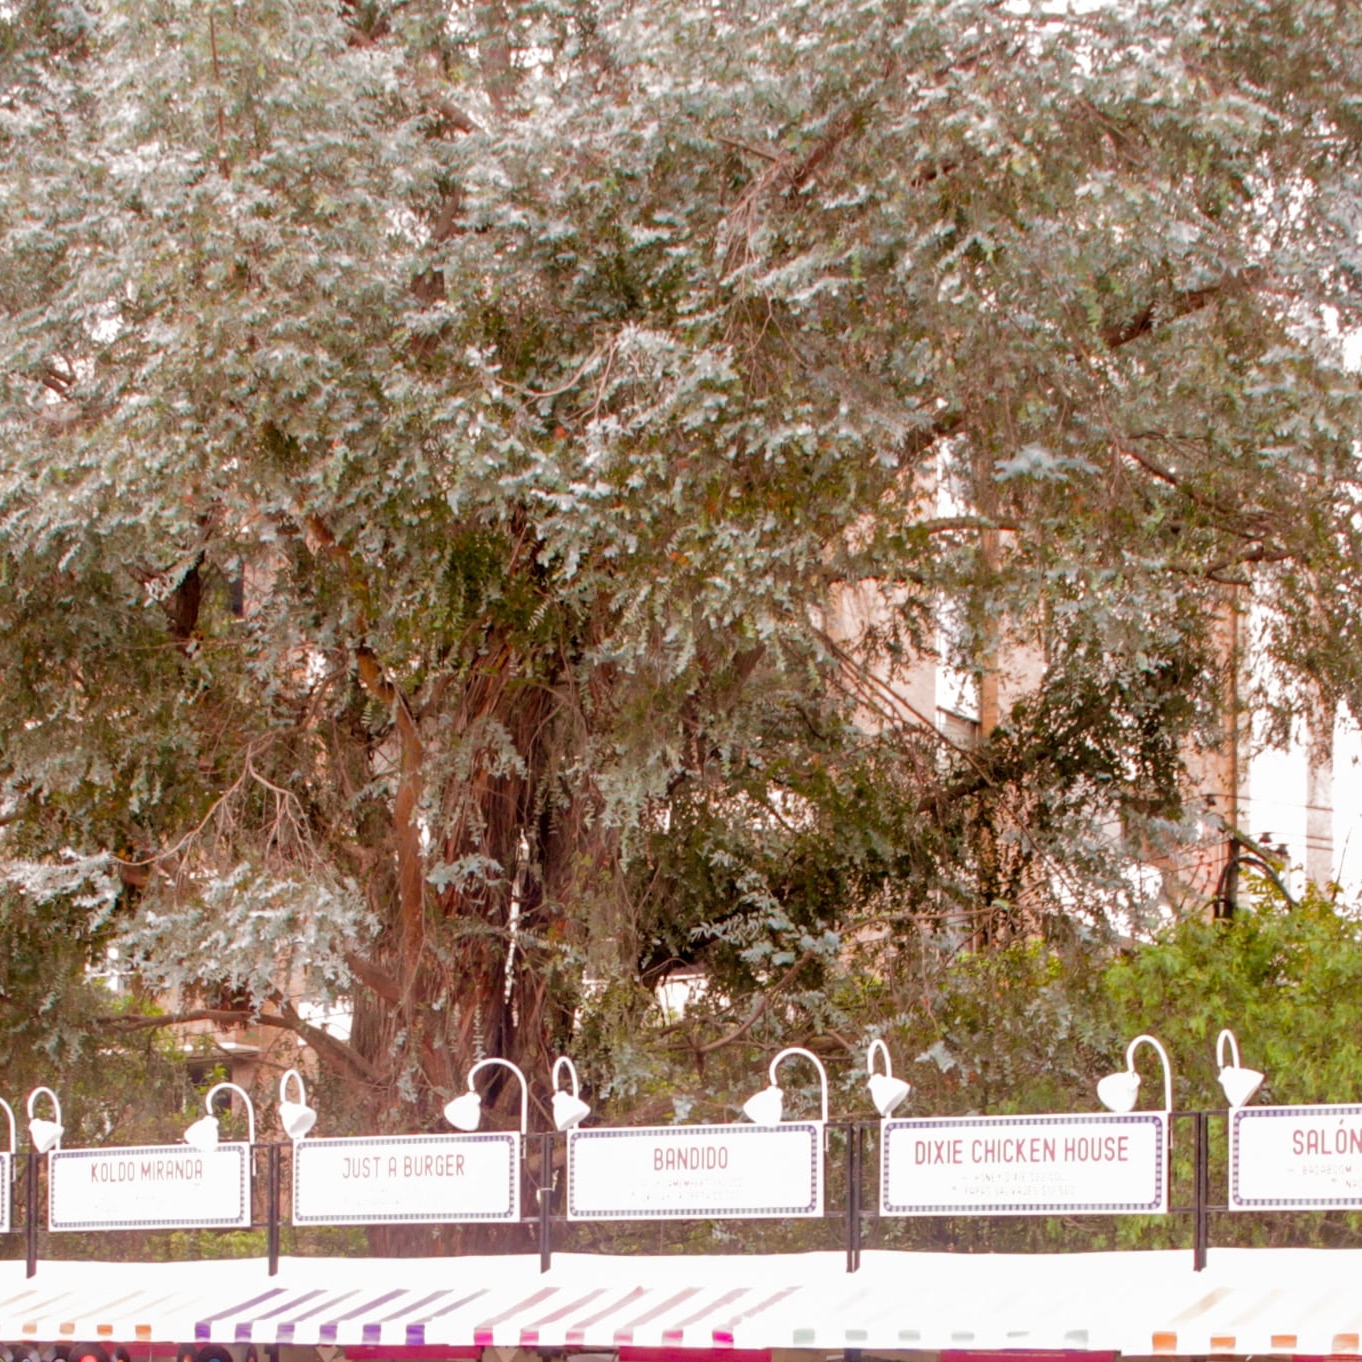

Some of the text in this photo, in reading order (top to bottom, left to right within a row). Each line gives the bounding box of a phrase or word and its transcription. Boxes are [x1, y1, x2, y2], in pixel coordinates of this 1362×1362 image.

[653, 1146, 728, 1171] BANDIDO
[914, 1135, 1129, 1165] DIXIE CHICKEN HOUSE
[91, 1159, 203, 1183] KOLDO MIRANDA
[342, 1154, 465, 1179] JUST A BURGER
